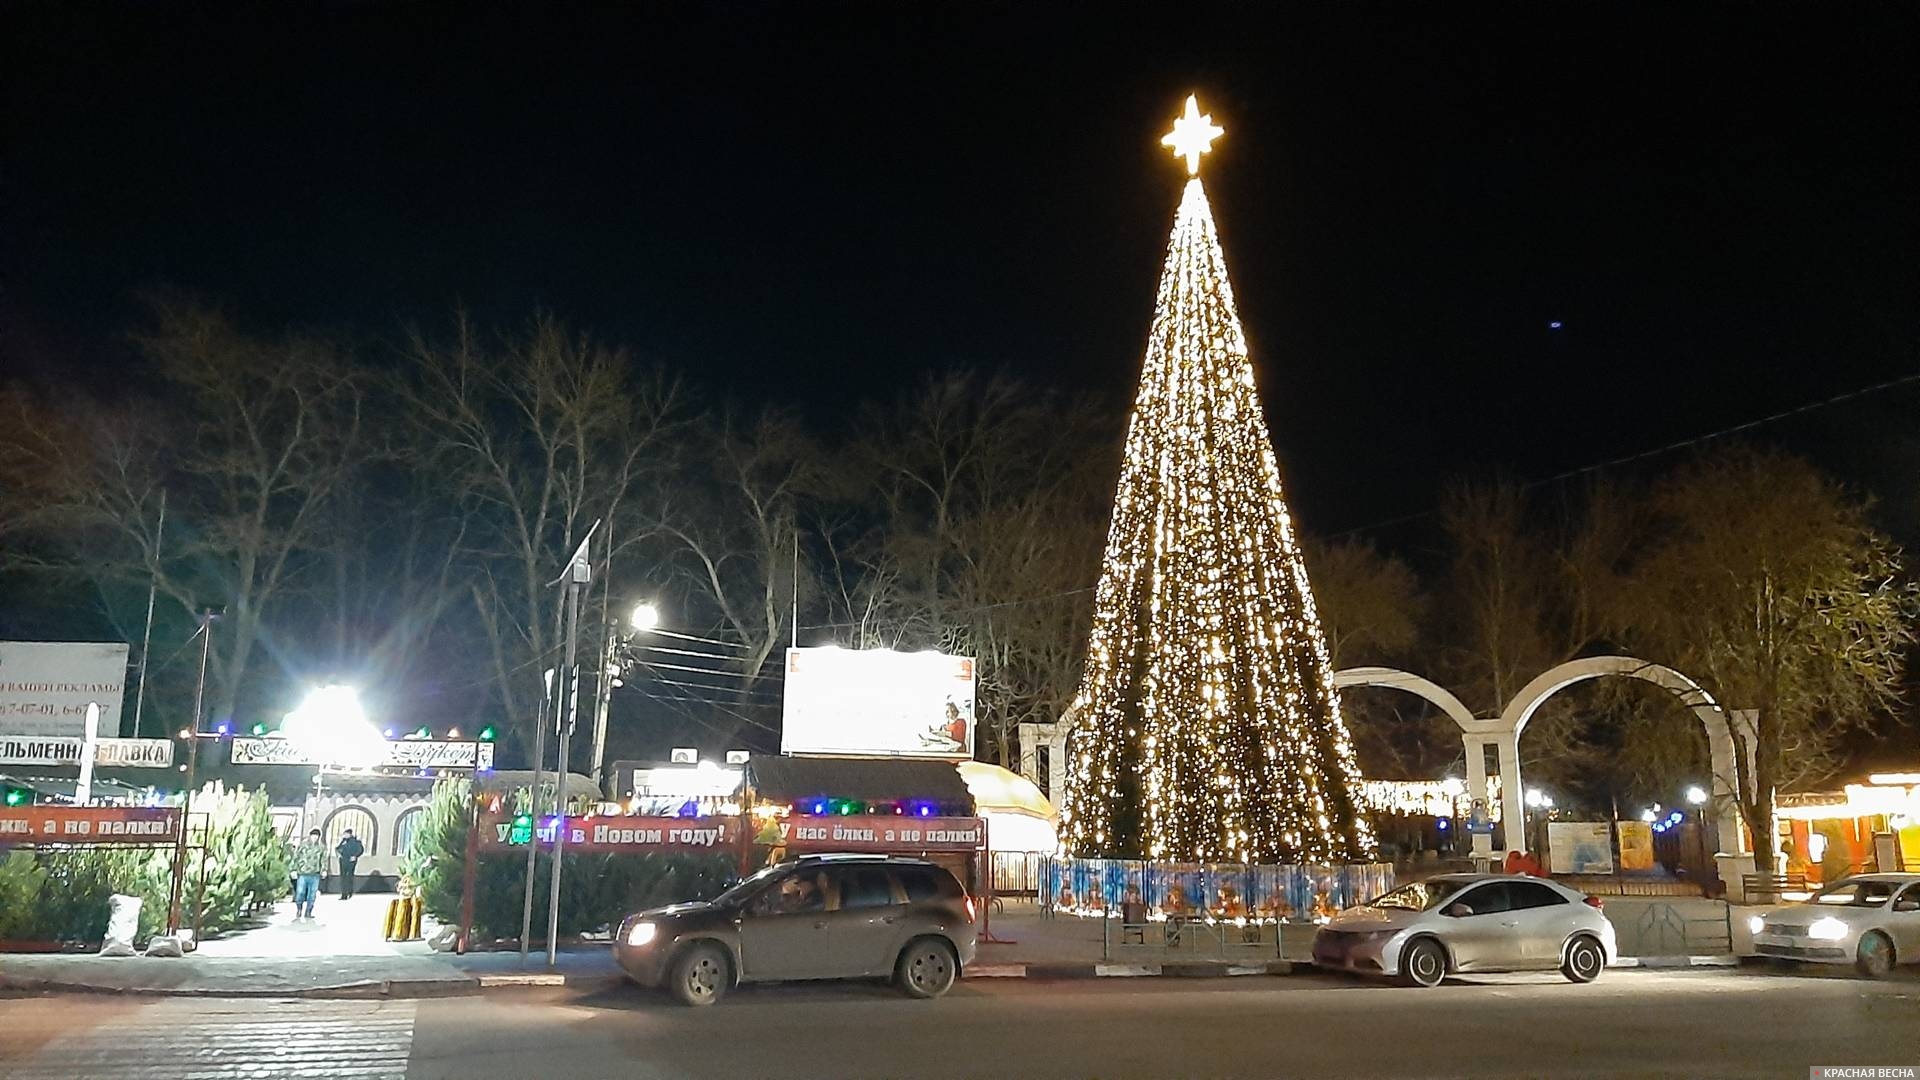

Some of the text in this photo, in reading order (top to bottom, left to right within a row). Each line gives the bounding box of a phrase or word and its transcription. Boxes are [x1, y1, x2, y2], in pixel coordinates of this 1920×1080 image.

[43, 820, 57, 834] а
[64, 820, 91, 835] не
[97, 814, 172, 835] палки!
[779, 823, 982, 843] У нас ёлки, а не палки!
[571, 829, 585, 843] в
[593, 825, 662, 844] Новом
[668, 825, 725, 847] году!
